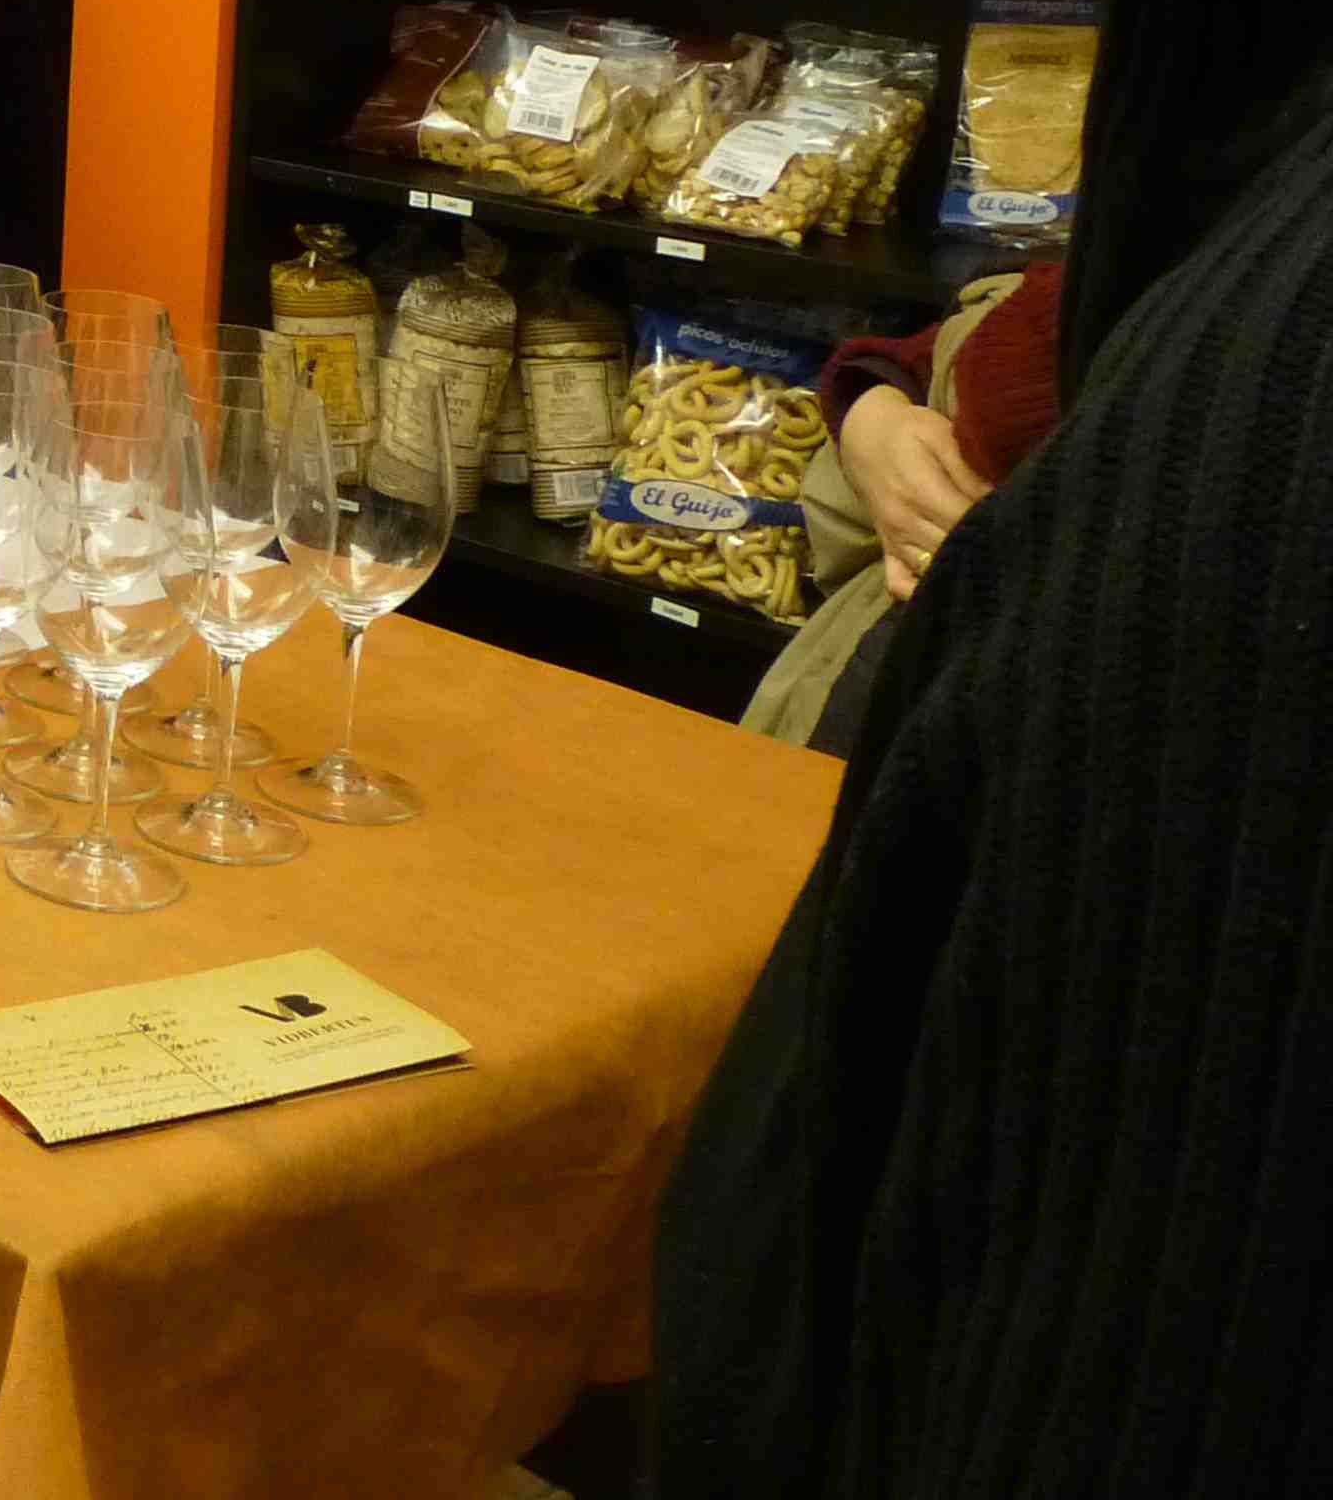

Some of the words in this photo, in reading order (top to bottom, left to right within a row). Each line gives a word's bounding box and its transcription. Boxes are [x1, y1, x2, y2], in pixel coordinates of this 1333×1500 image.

[977, 197, 993, 212] El
[999, 197, 1050, 216] Guijo
[677, 323, 724, 345] picos
[642, 487, 667, 506] El
[671, 492, 734, 521] Guijo
